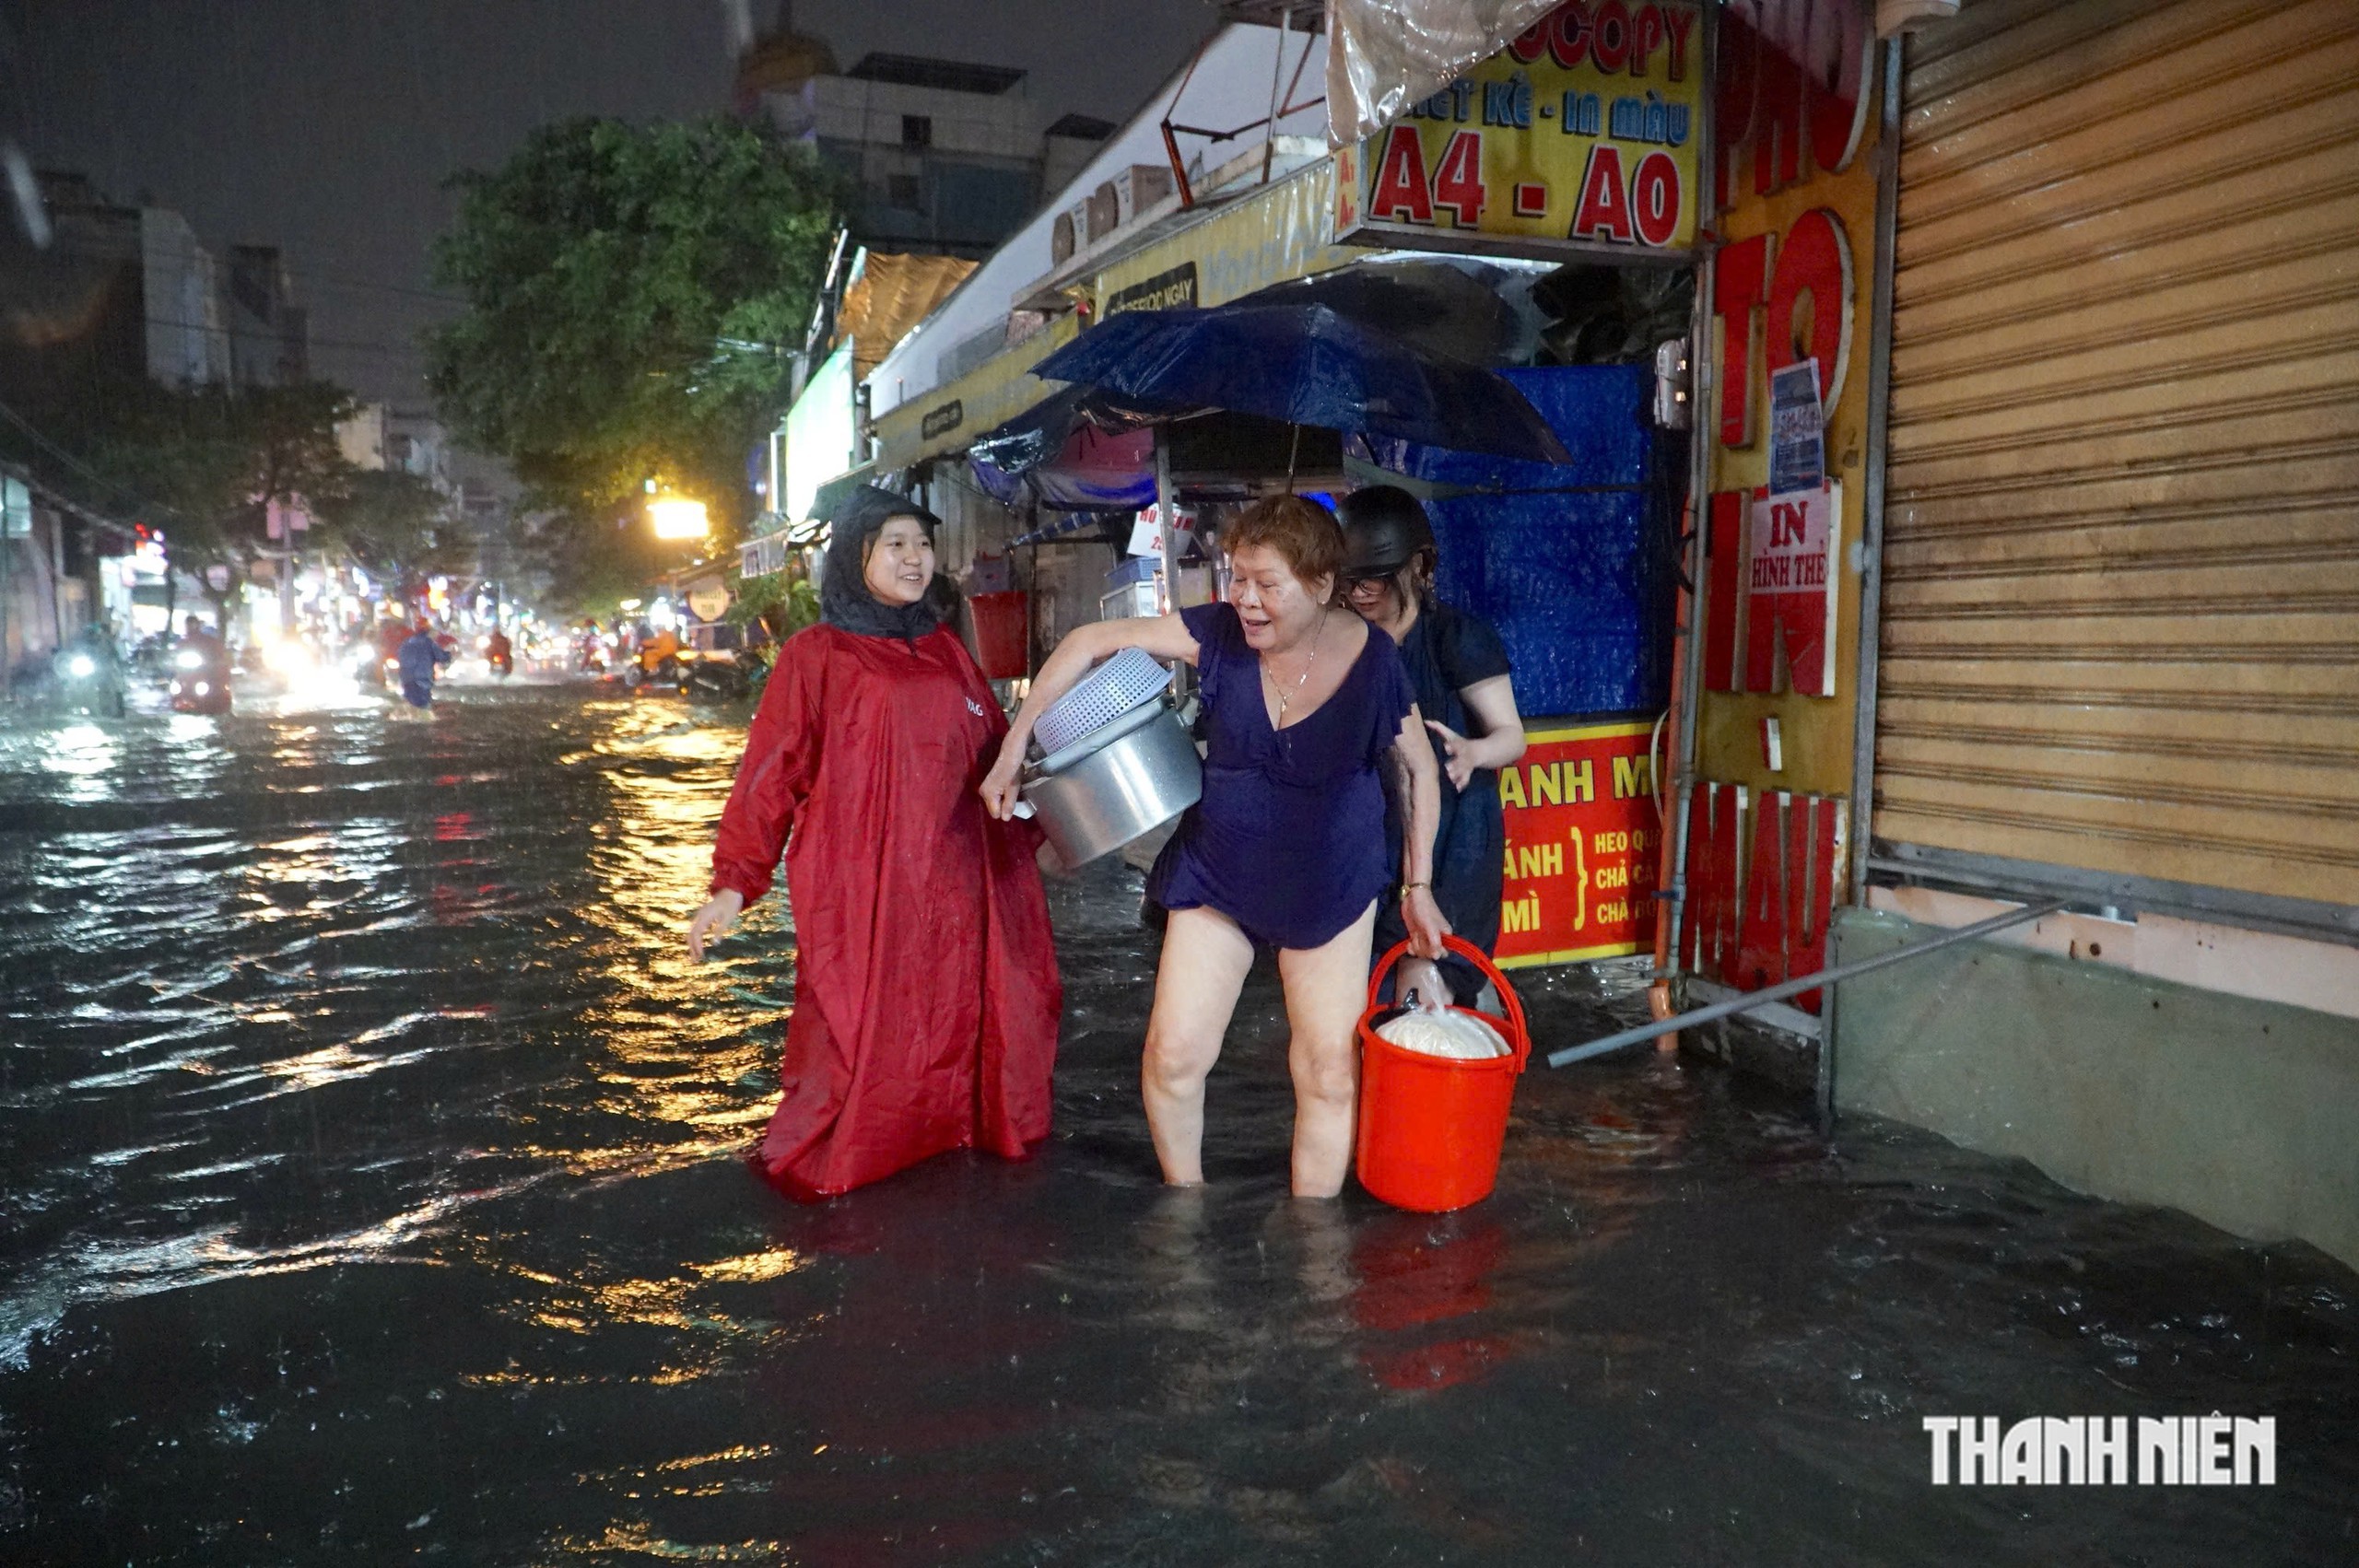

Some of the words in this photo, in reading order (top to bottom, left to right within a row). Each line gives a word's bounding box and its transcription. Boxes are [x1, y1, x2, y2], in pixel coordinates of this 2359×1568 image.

[1367, 124, 1486, 228] A4
[1570, 145, 1681, 247] A0
[1715, 208, 1853, 449] TO
[1770, 500, 1809, 548] IN
[1751, 547, 1790, 588] HÌNH
[1795, 538, 1826, 586] THẺ
[1503, 837, 1564, 881] ÁNH
[1595, 830, 1628, 855] HEO
[1596, 859, 1628, 890] CHẢ
[1502, 889, 1541, 934] MÌ
[1597, 895, 1629, 925] CHÀ
